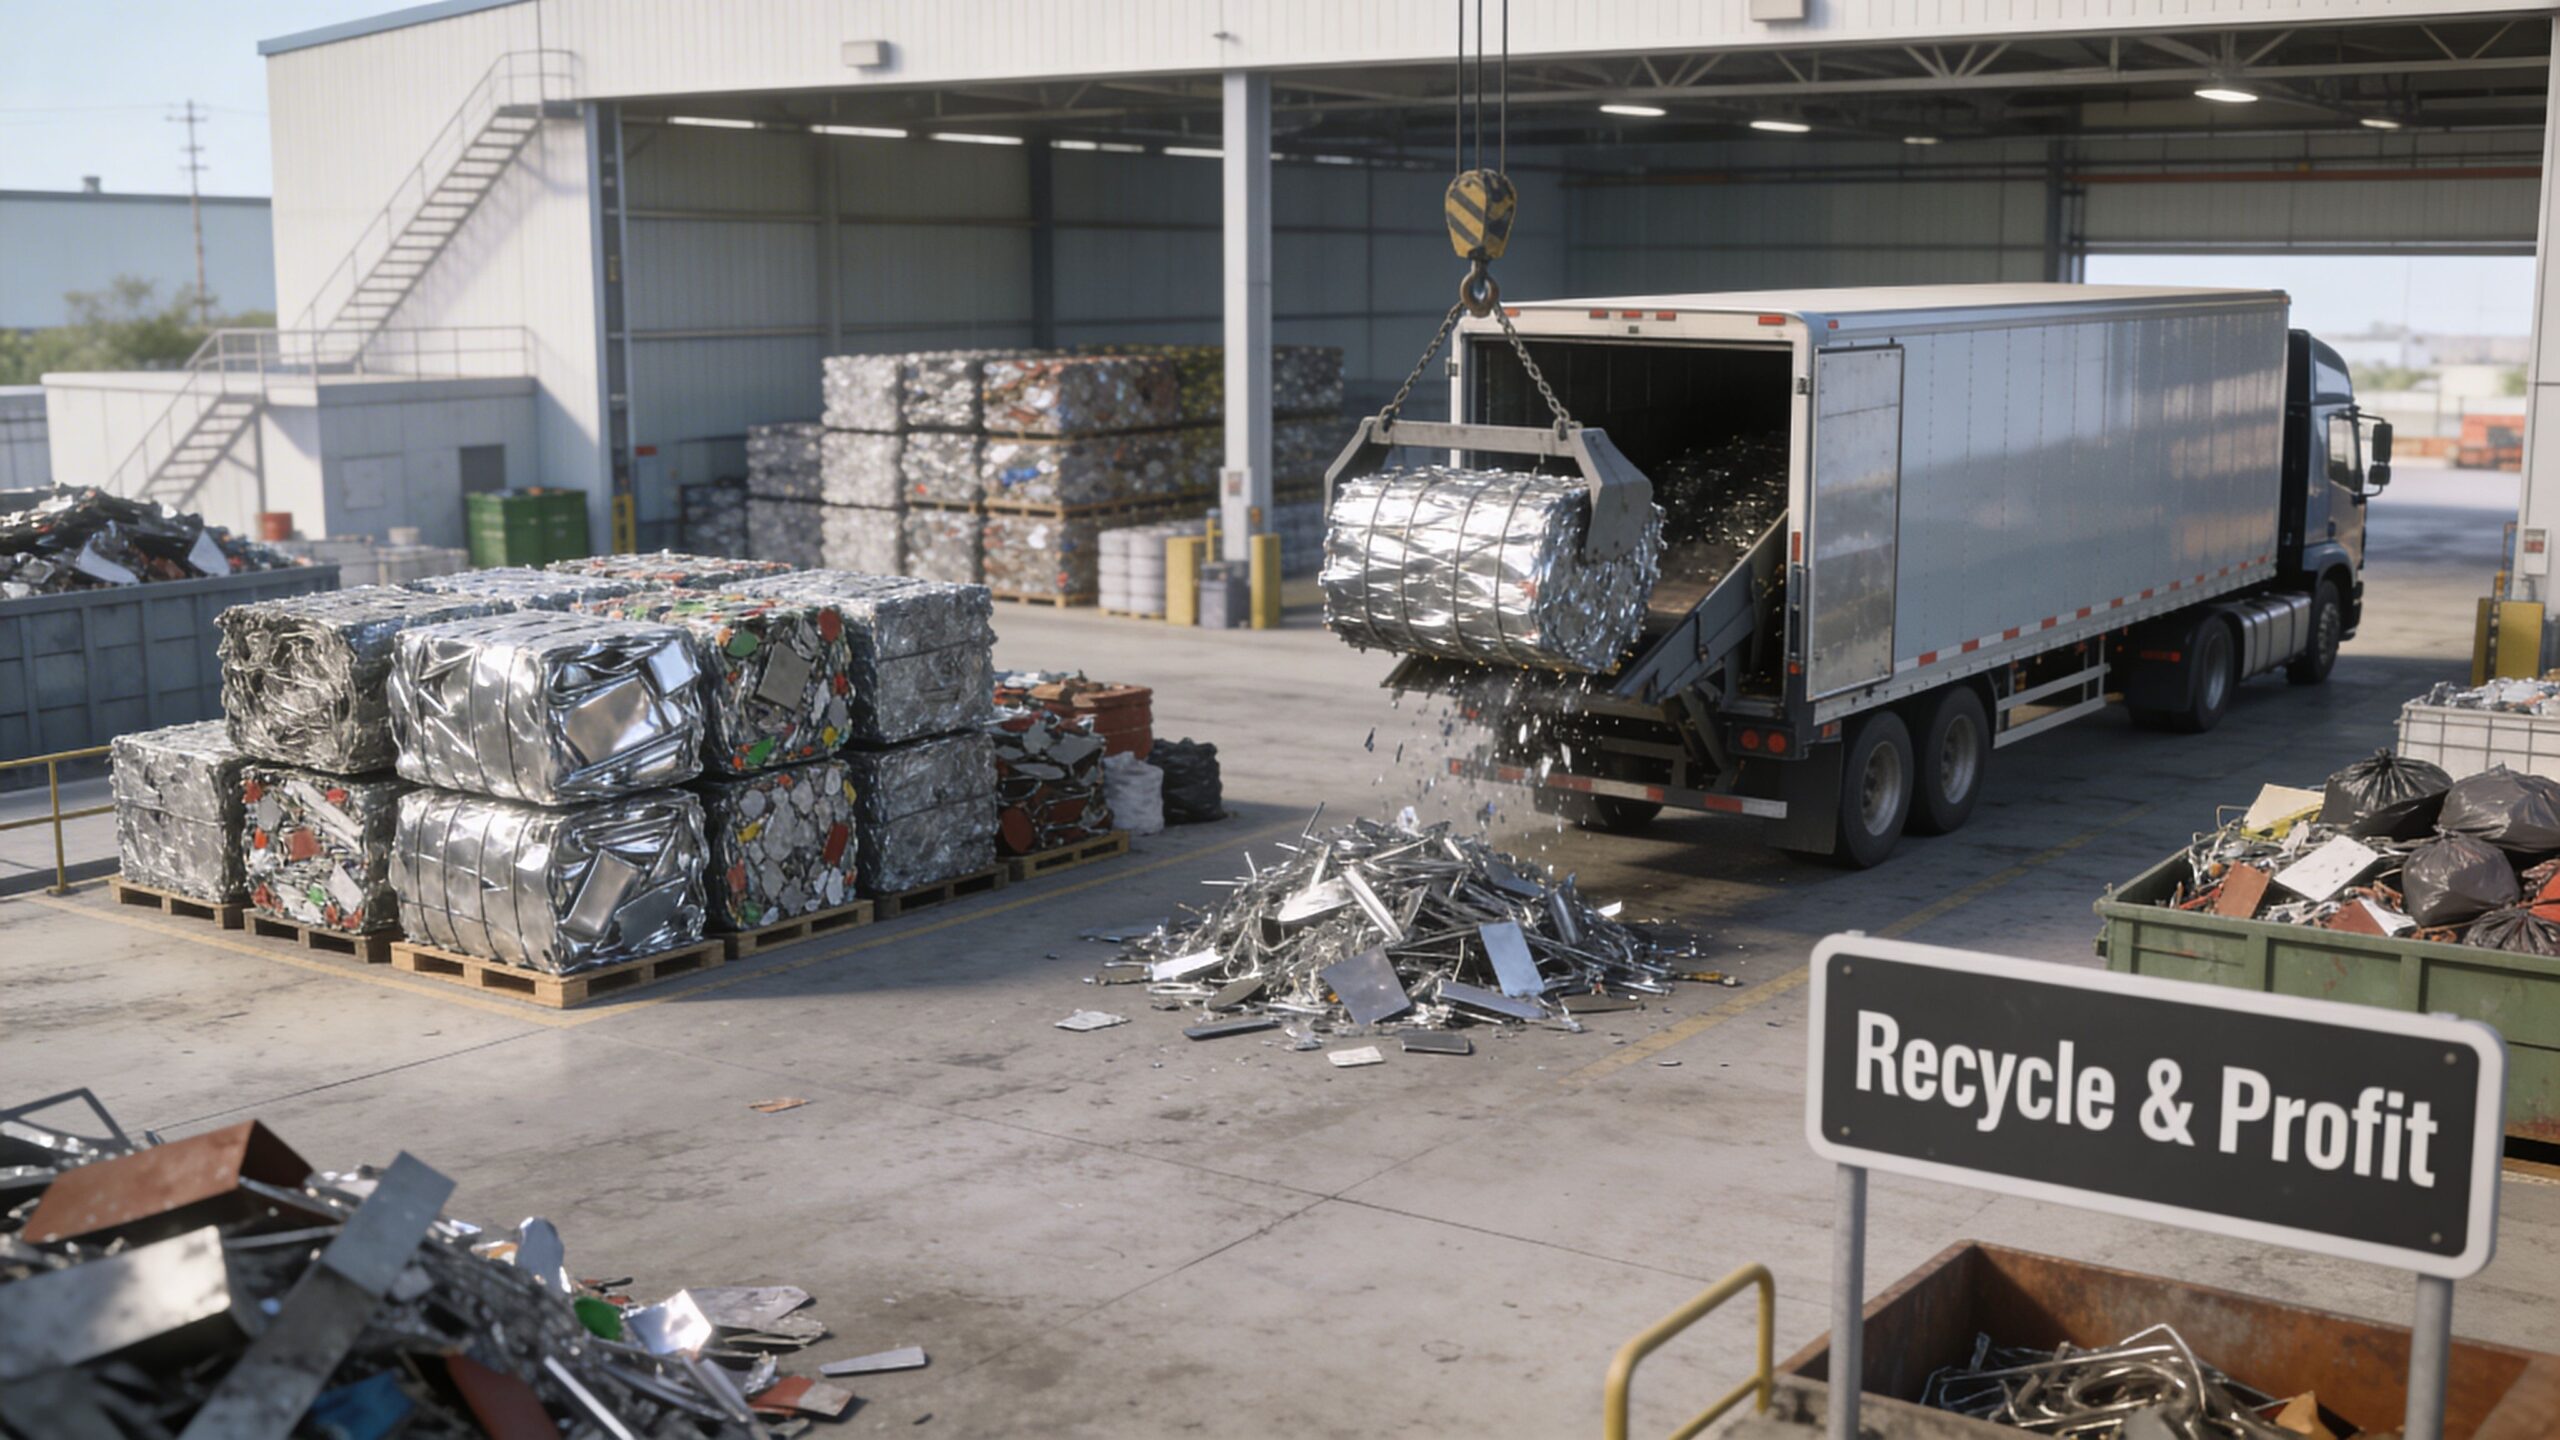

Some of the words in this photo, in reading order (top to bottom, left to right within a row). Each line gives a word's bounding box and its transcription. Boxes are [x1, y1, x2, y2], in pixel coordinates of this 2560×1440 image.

[1855, 1010, 2115, 1132] Recycle
[2139, 1058, 2194, 1146] &
[2219, 1066, 2438, 1187] Profit
